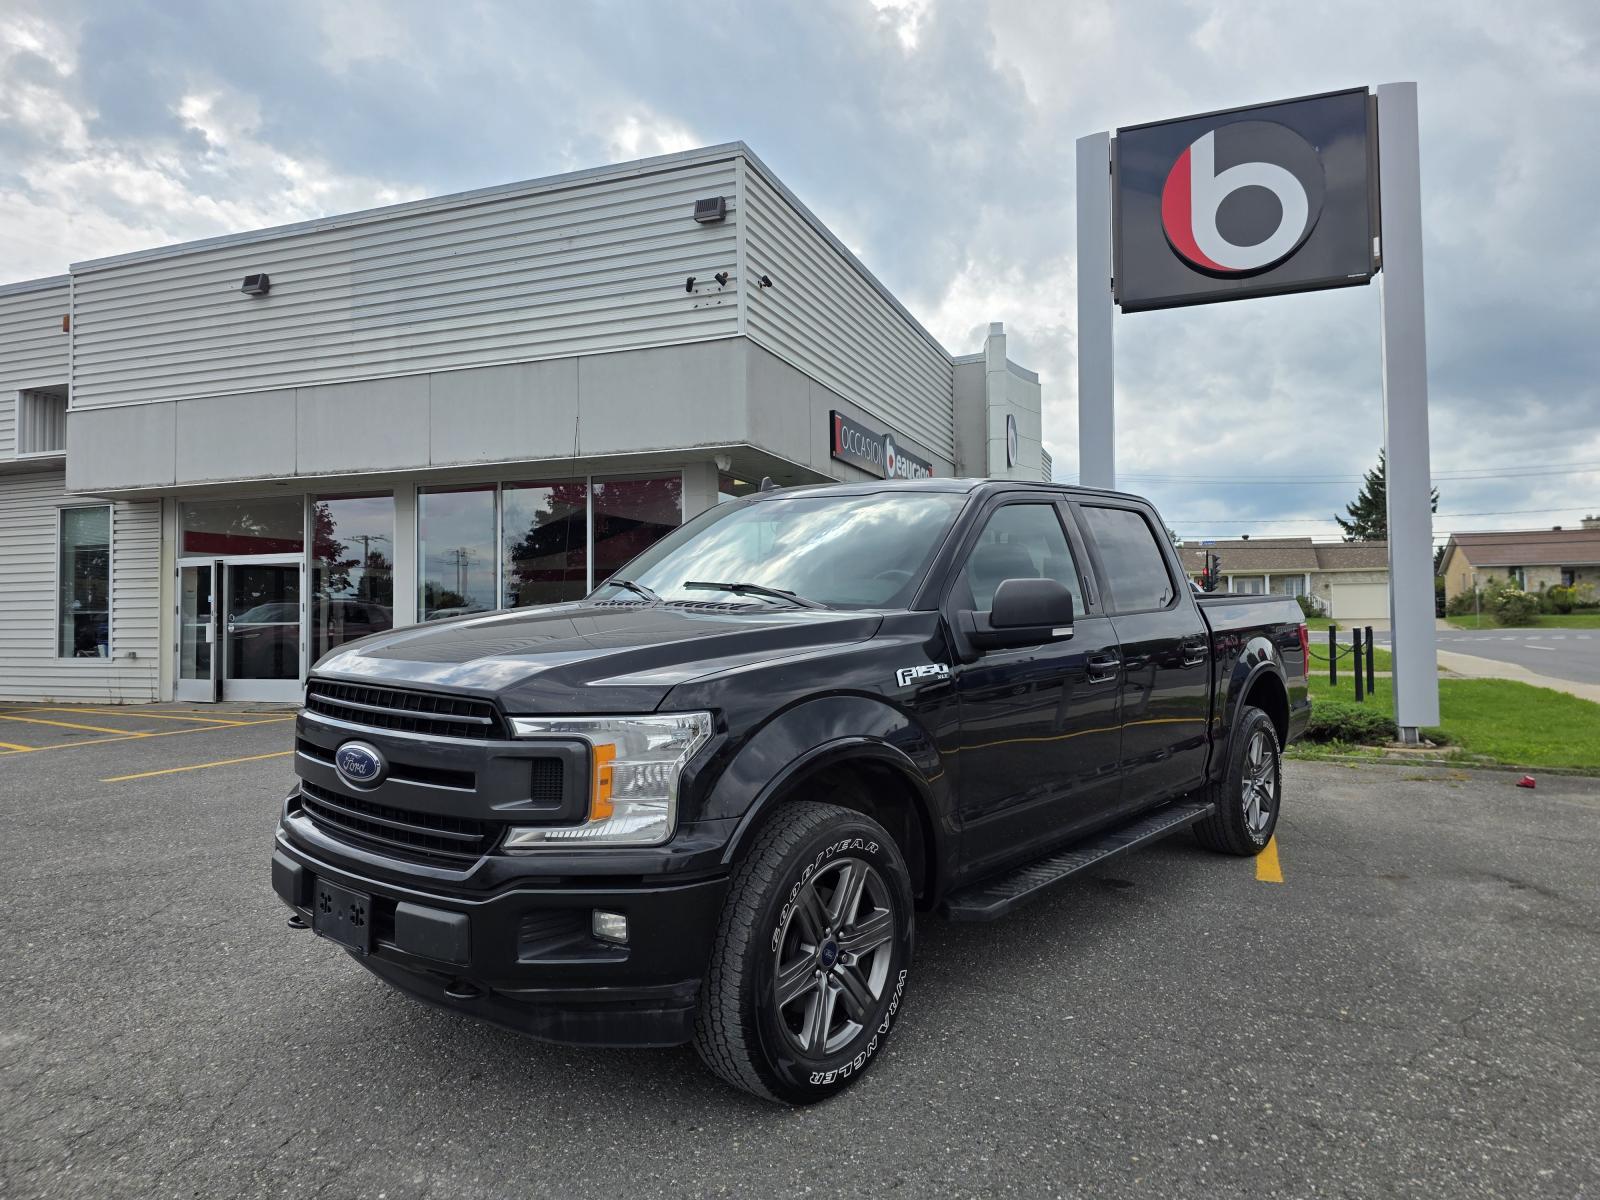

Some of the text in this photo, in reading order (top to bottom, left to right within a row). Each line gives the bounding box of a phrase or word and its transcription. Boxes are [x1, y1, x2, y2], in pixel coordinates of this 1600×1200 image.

[841, 425, 884, 465] OCCASION
[342, 751, 368, 774] Ford
[809, 969, 908, 1085] WRANGLER
